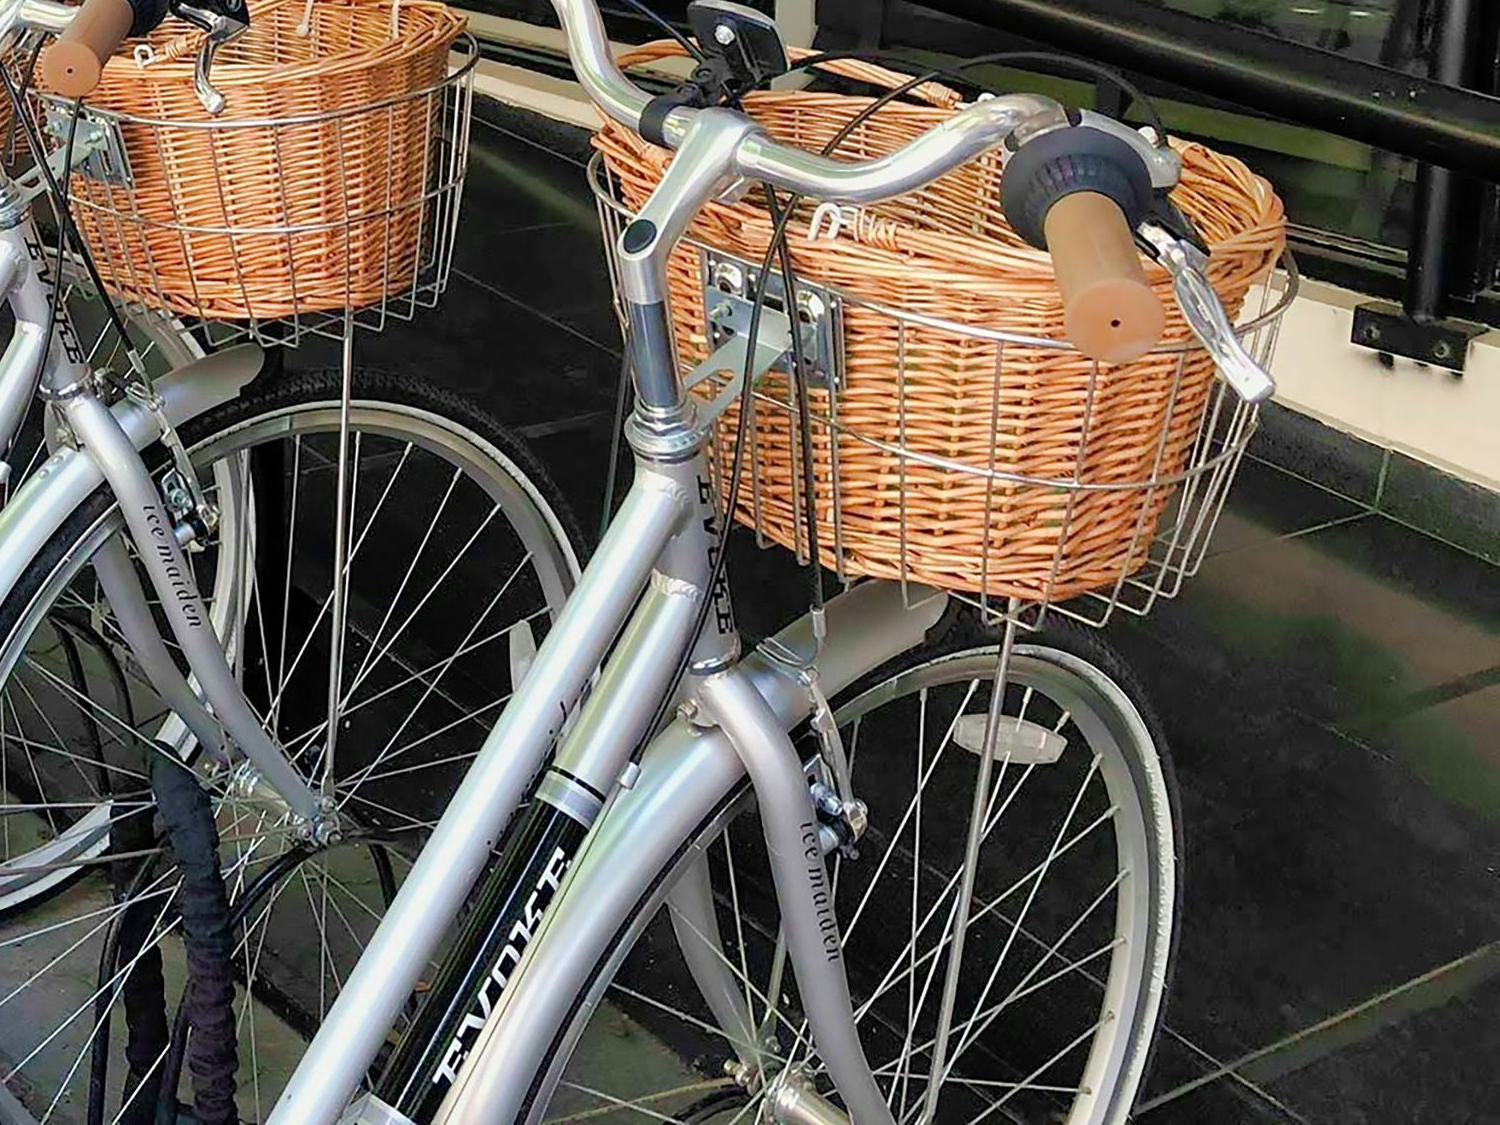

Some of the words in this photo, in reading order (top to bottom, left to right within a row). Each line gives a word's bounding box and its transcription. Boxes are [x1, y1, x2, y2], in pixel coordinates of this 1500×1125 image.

[143, 505, 164, 538] ice
[157, 545, 202, 628] maiden
[799, 822, 819, 862] ice
[808, 868, 840, 962] maiden
